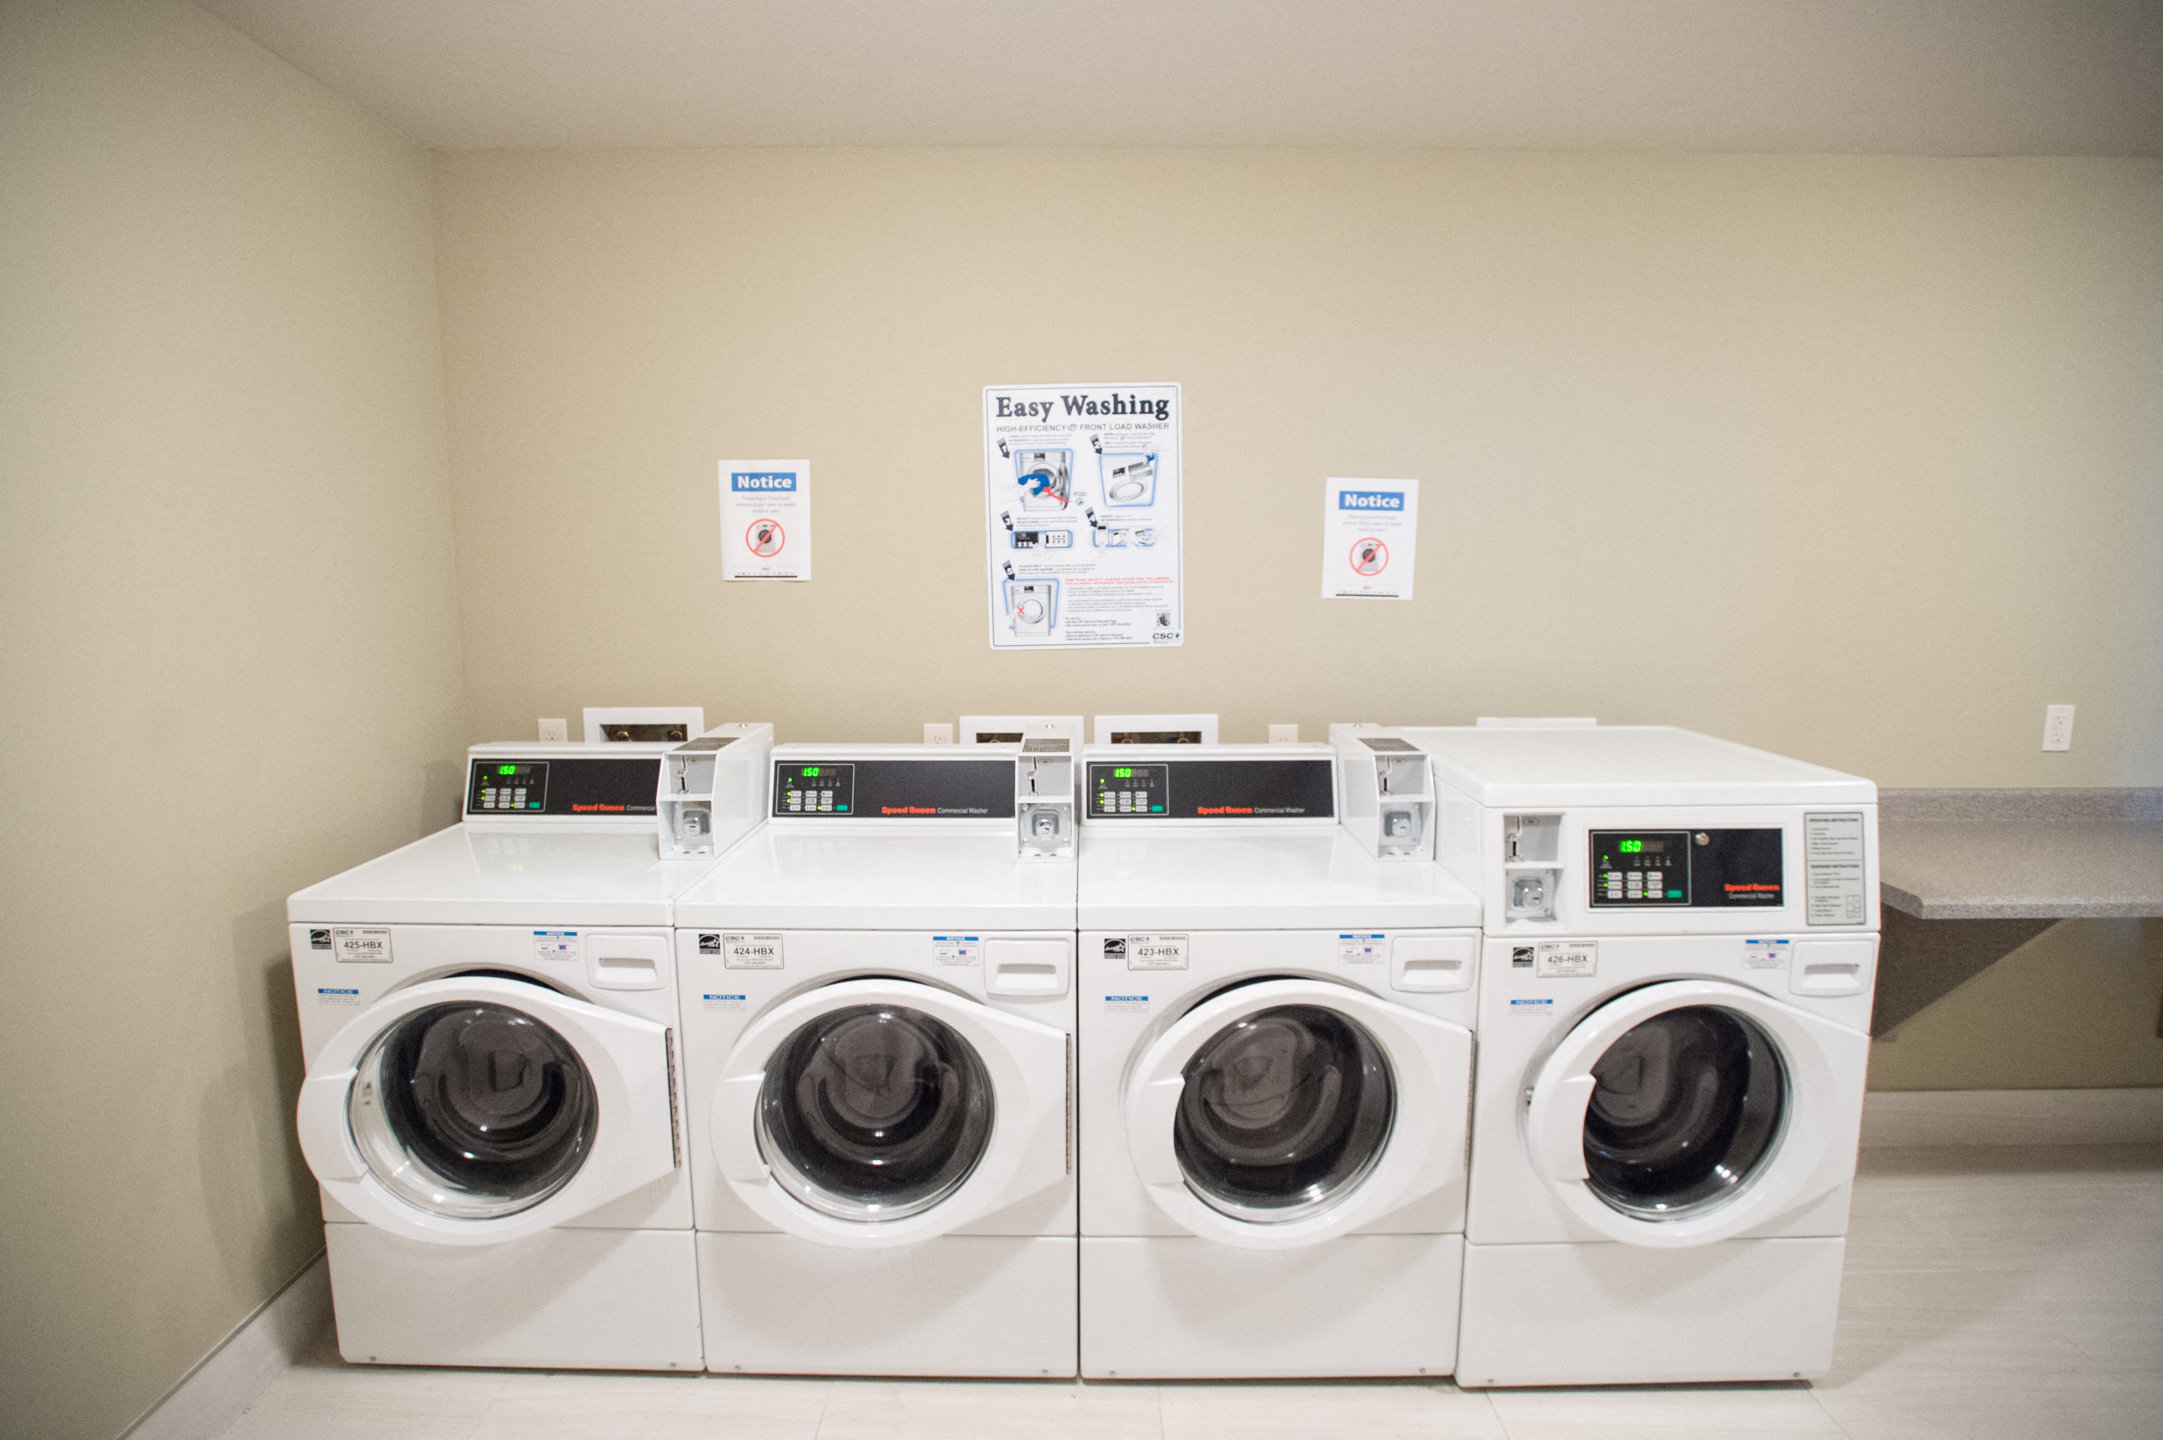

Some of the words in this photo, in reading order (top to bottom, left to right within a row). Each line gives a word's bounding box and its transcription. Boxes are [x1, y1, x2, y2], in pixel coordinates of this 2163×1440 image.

[996, 397, 1054, 422] Easy
[1060, 394, 1170, 420] Washing
[738, 476, 792, 488] Notice
[1344, 494, 1400, 508] Notice
[572, 803, 598, 812] Speed
[882, 806, 908, 815] Speed
[1197, 806, 1224, 815] Speed
